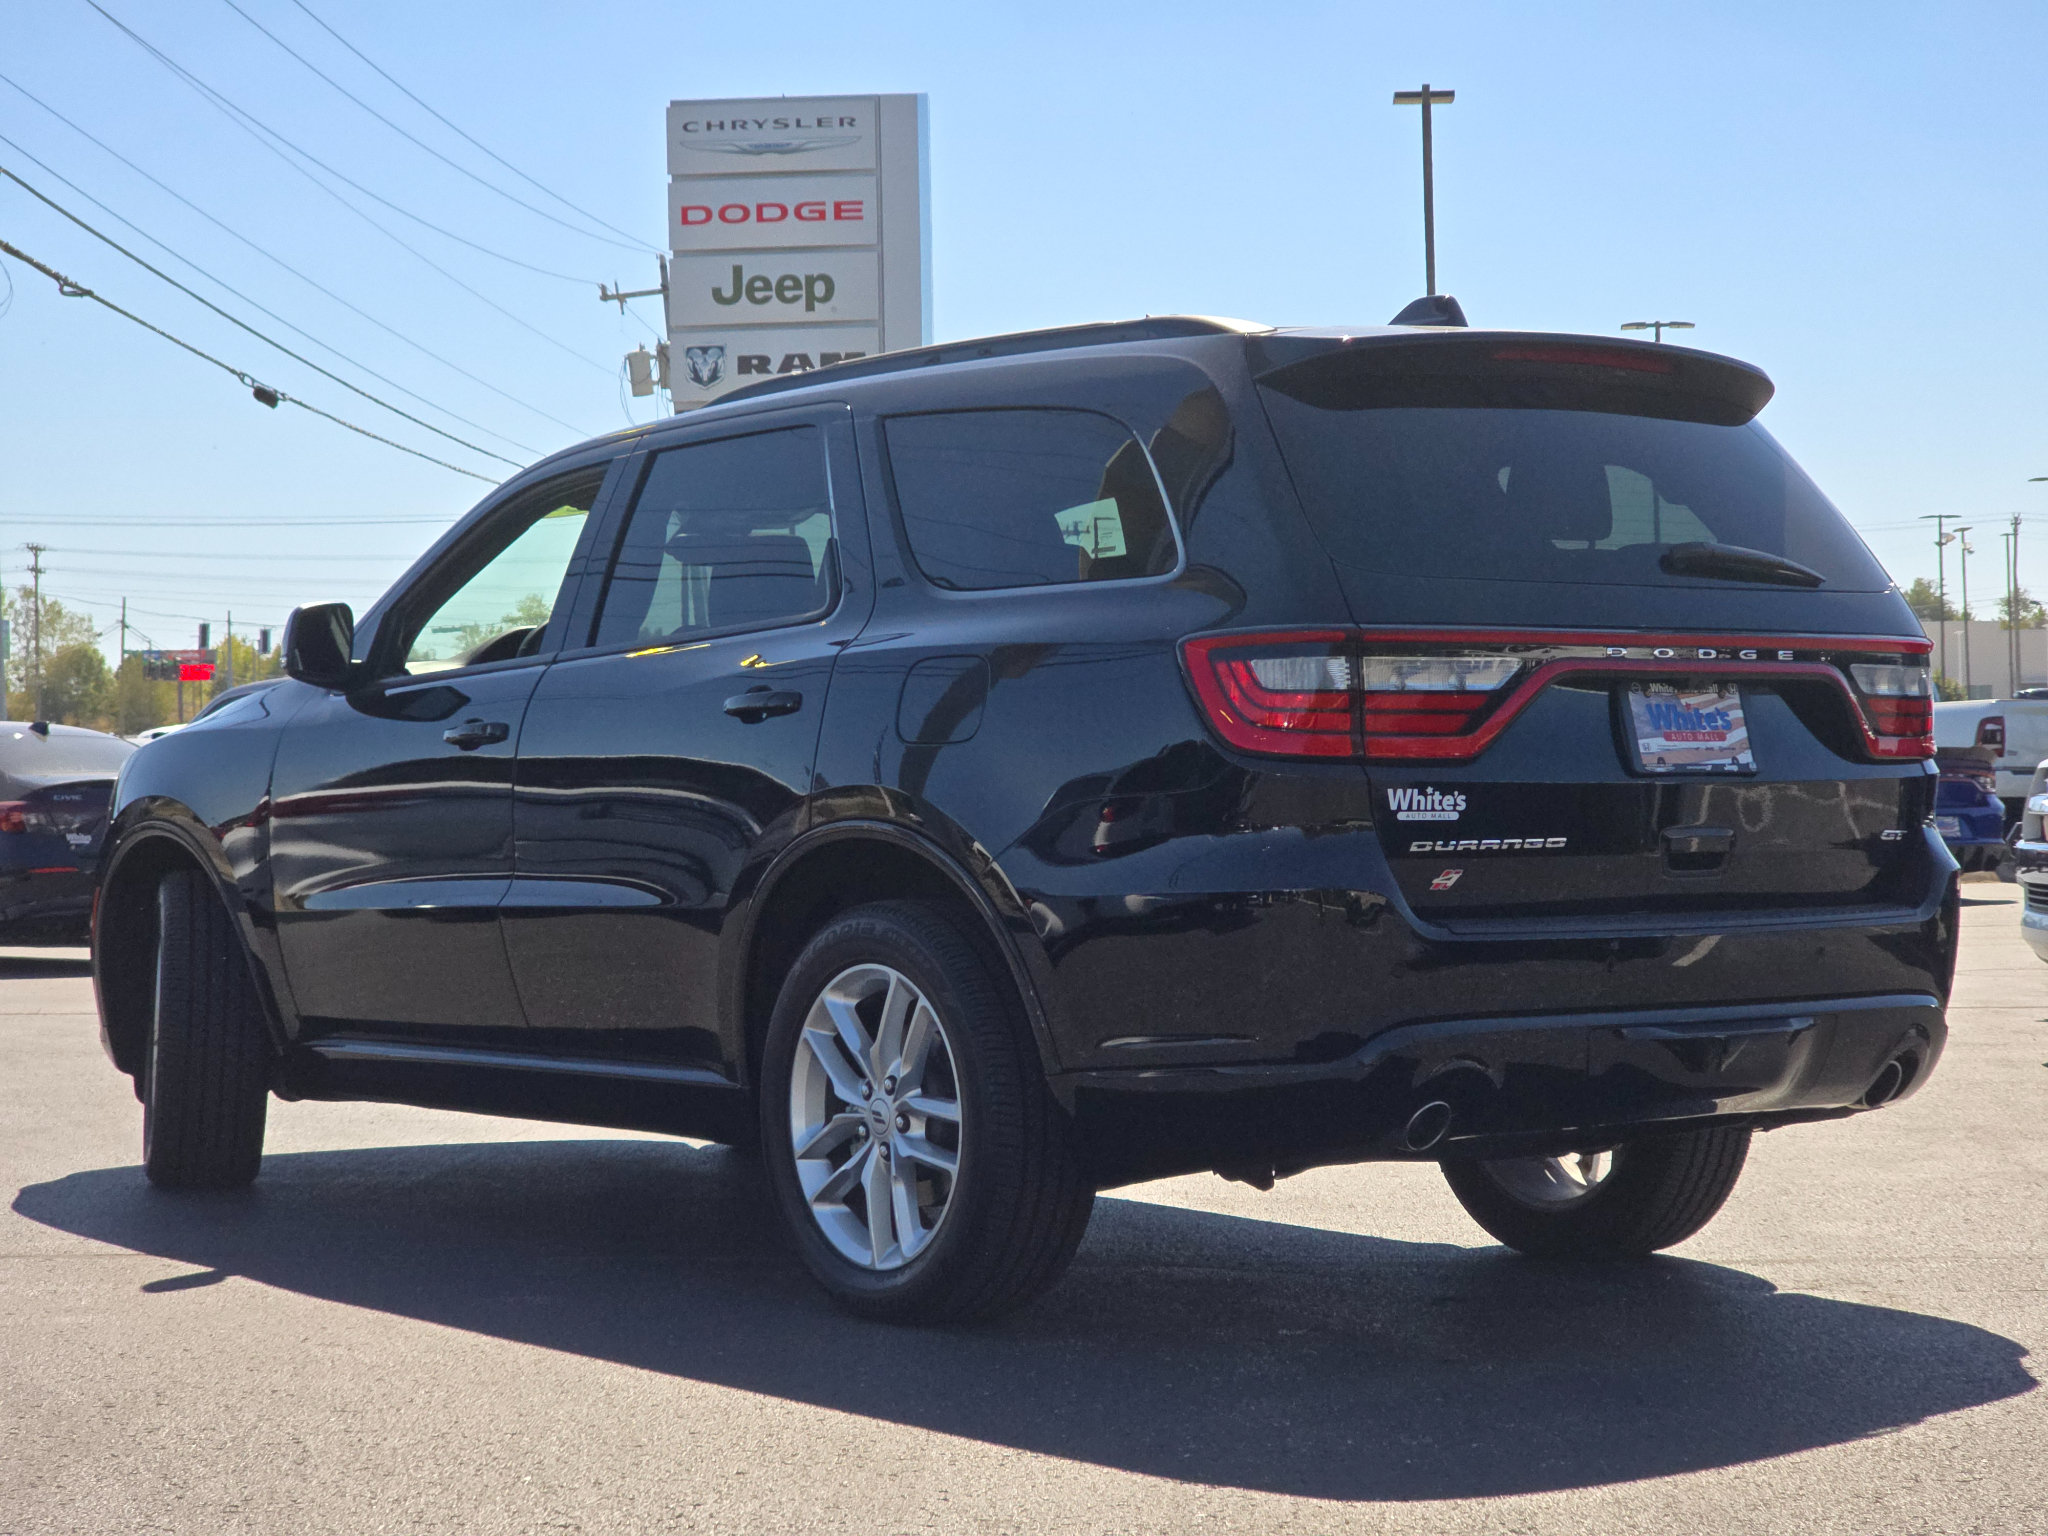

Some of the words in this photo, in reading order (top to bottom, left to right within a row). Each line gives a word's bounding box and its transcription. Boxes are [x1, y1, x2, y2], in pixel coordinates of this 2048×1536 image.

[682, 116, 857, 133] CHRYSLER
[681, 200, 864, 226] DODGE
[711, 264, 836, 312] Jeep
[1606, 646, 1795, 661] DODGE
[1645, 701, 1732, 731] White's
[1671, 733, 1693, 741] AUTO
[1696, 733, 1719, 741] MALL
[1387, 786, 1467, 811] White's
[1880, 829, 1908, 841] GT
[1409, 837, 1568, 852] DURANGO
